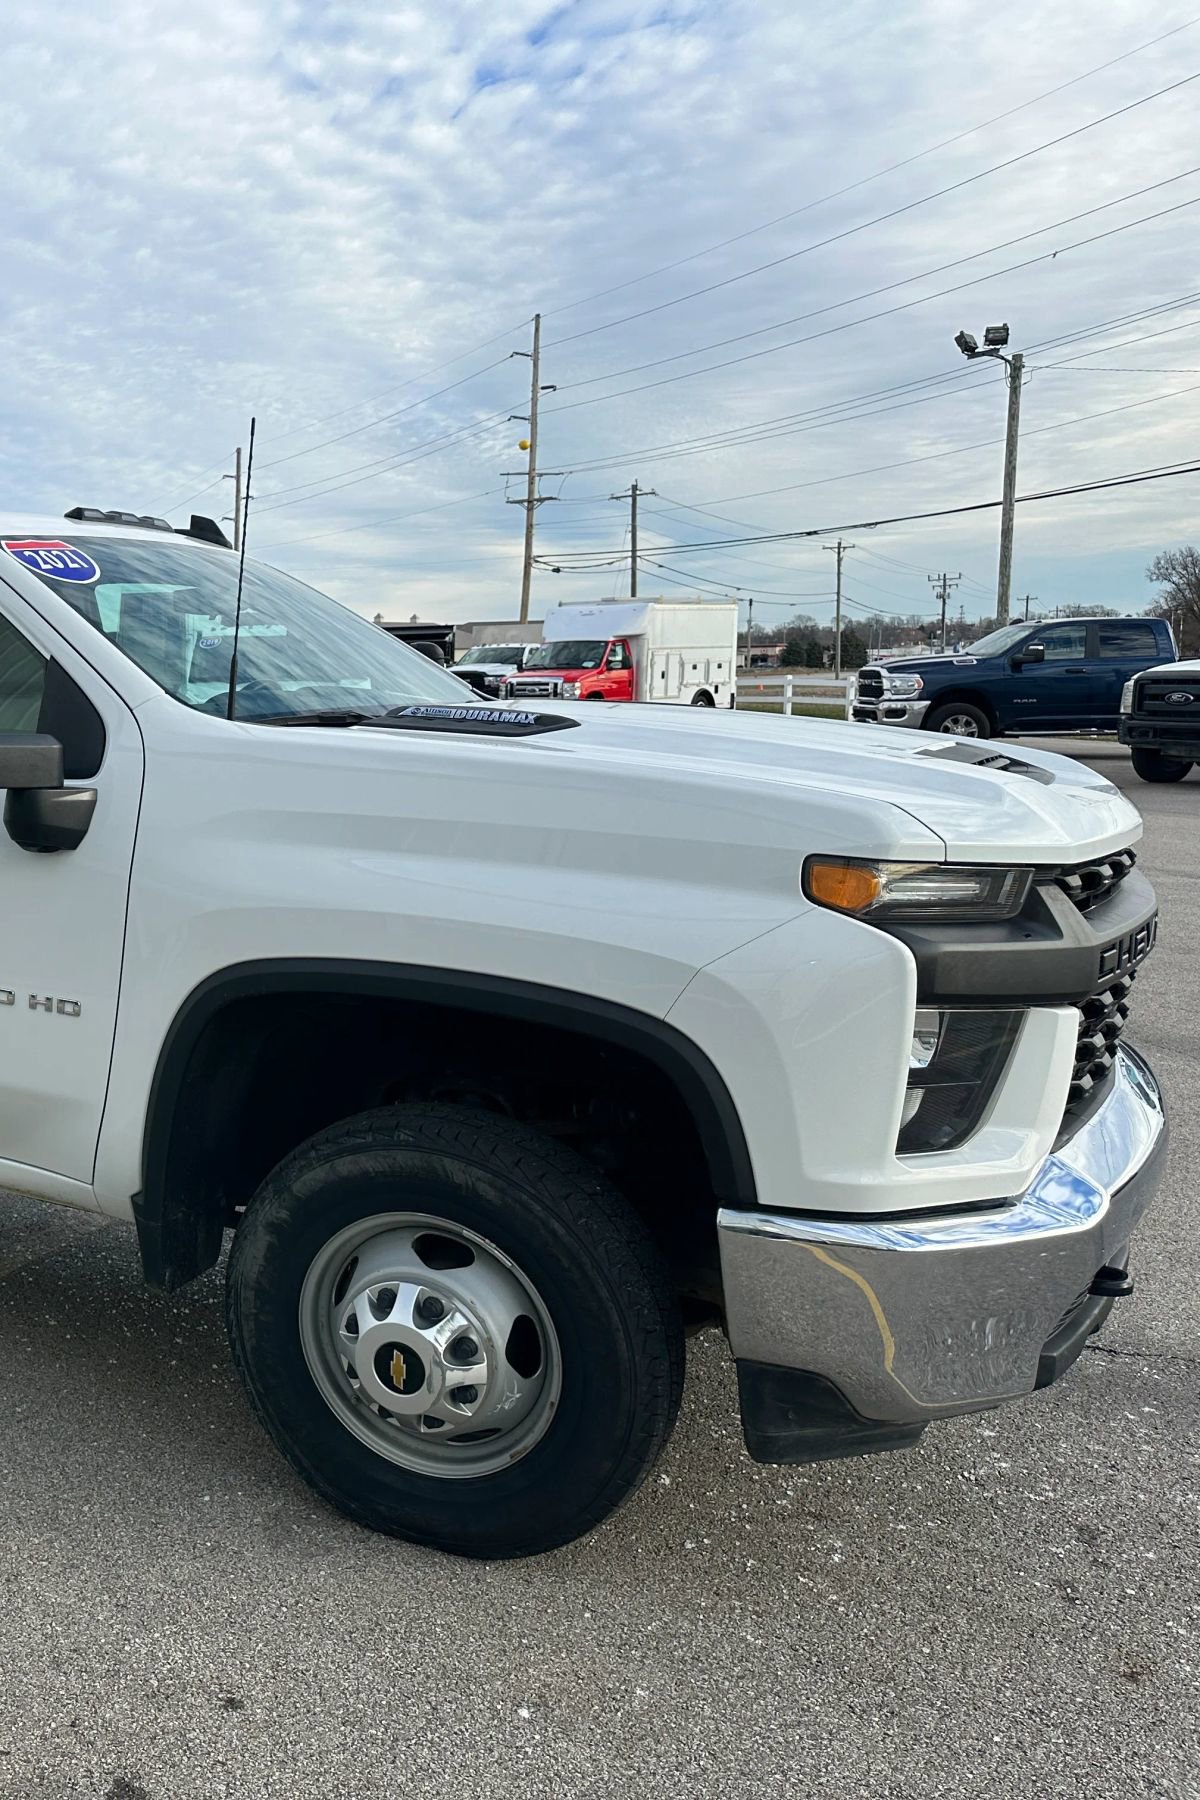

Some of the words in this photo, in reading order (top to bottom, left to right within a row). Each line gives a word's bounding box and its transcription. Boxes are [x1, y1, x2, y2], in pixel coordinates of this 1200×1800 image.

[23, 550, 89, 570] 2021
[454, 708, 538, 725] DURAMAX
[28, 993, 82, 1017] HD
